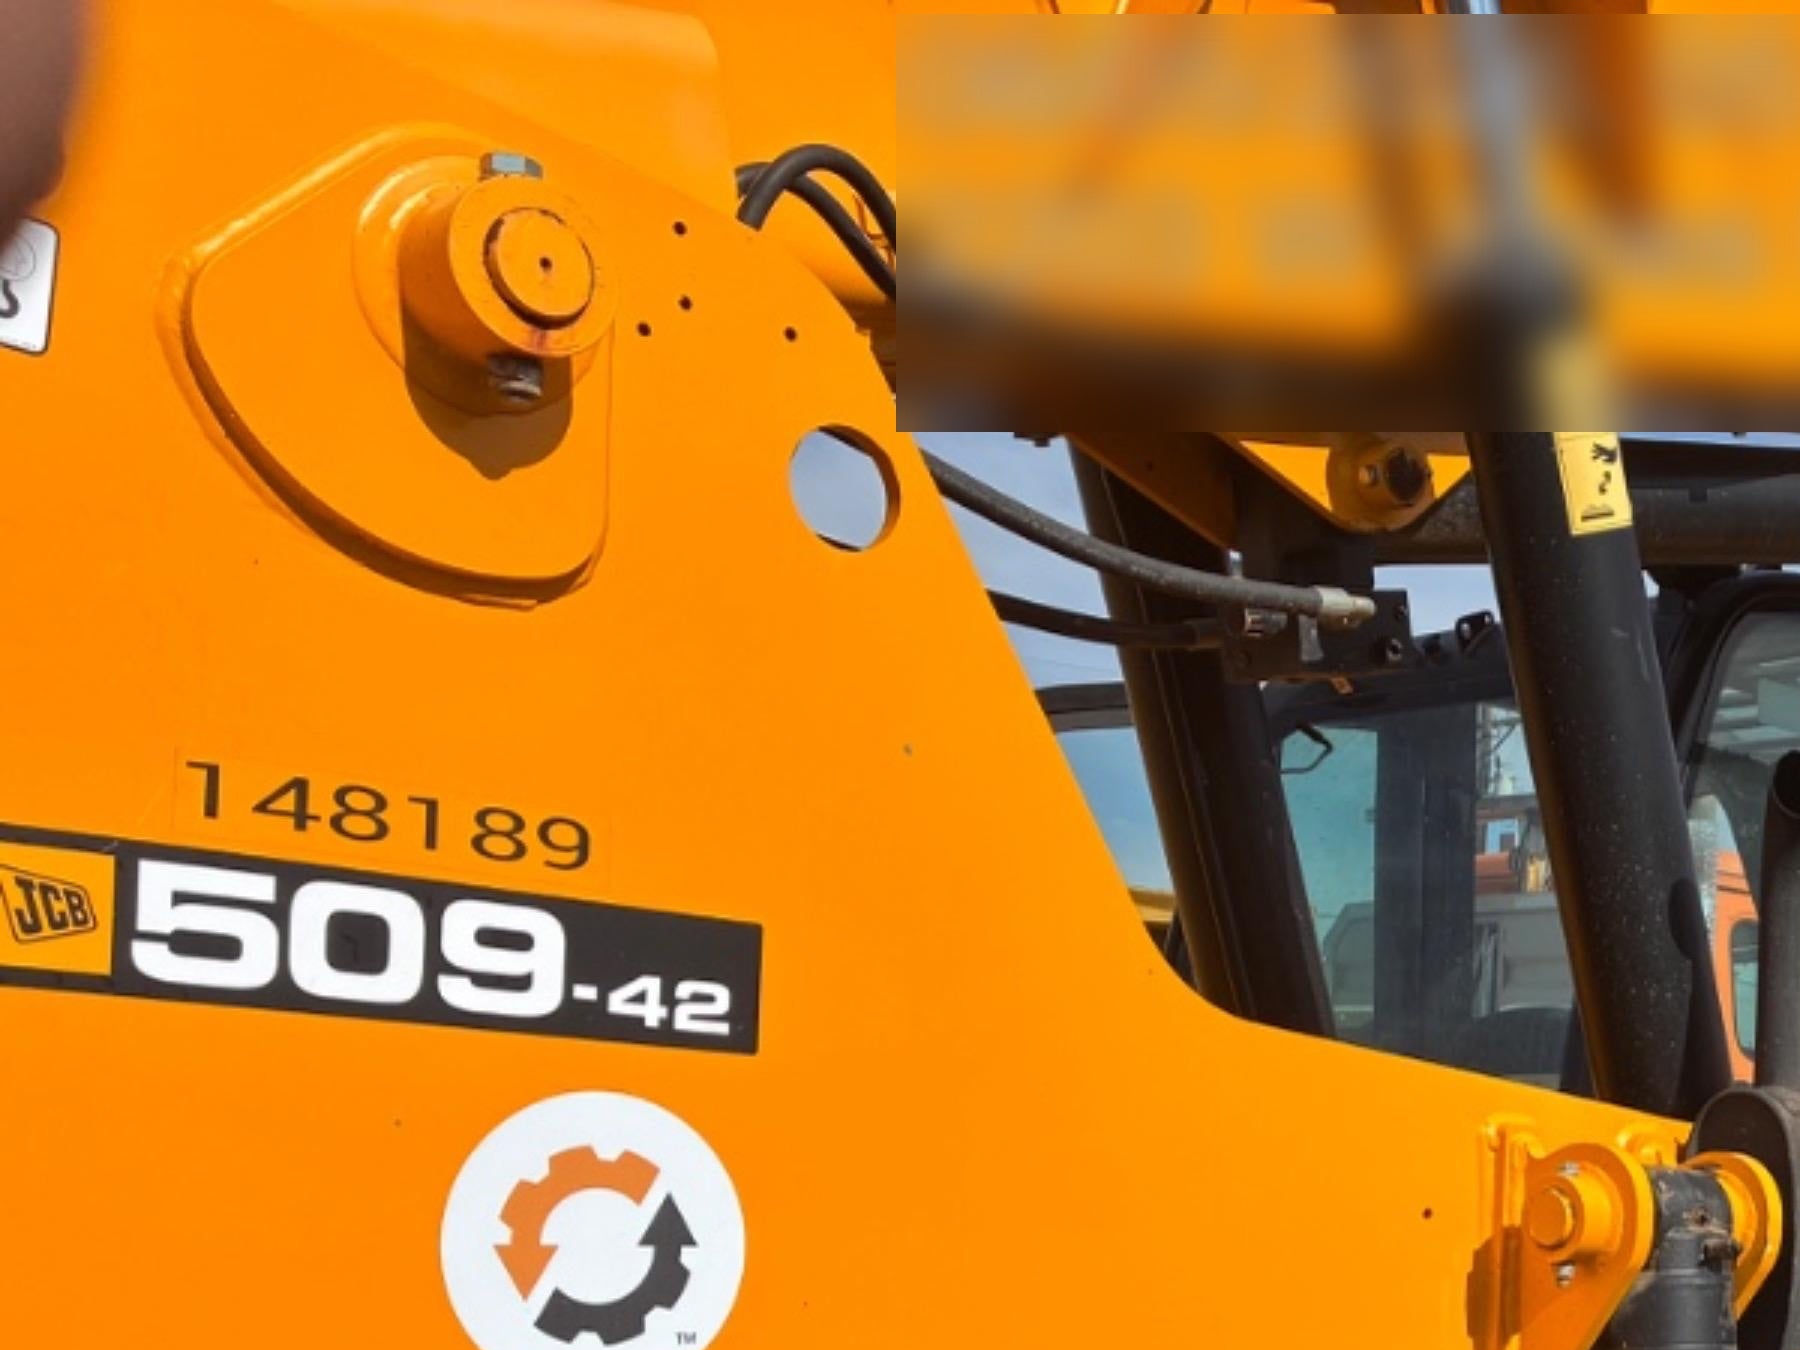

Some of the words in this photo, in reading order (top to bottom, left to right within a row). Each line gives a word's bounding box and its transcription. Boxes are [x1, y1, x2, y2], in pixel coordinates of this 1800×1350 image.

[187, 761, 591, 871] 148189
[14, 874, 89, 934] JCB
[131, 859, 731, 1036] 509-42
[674, 1331, 697, 1345] TM
